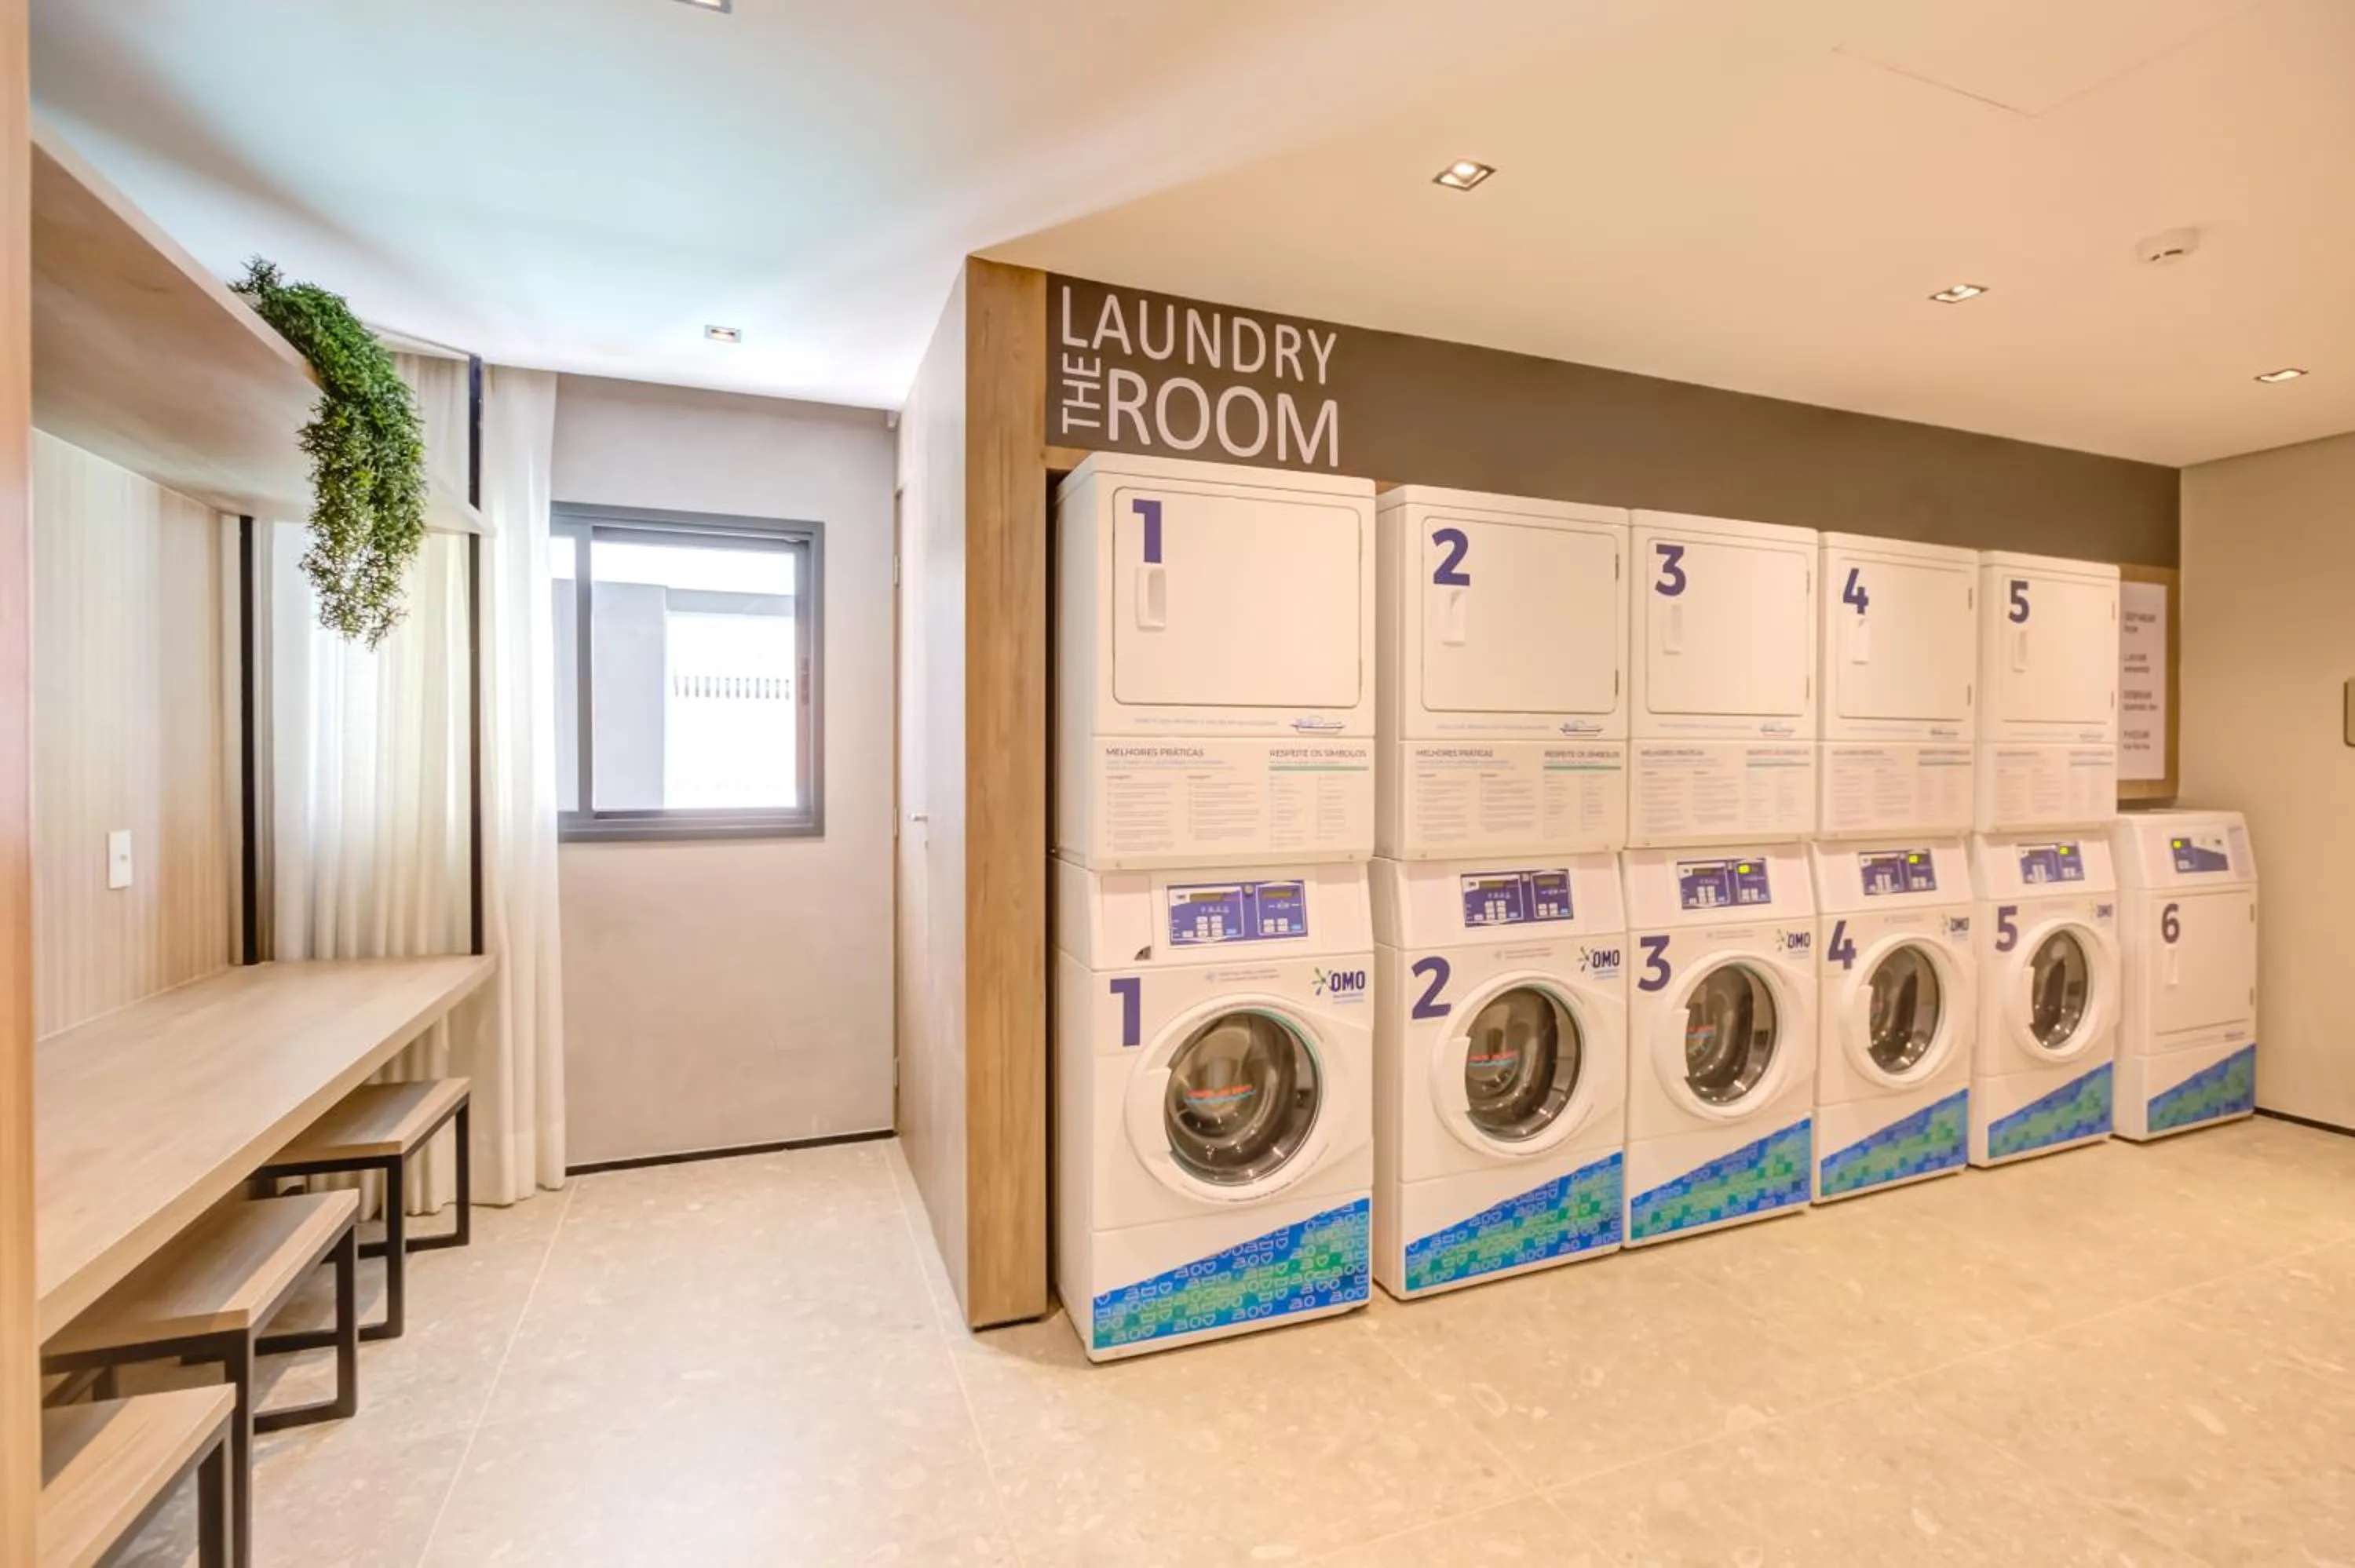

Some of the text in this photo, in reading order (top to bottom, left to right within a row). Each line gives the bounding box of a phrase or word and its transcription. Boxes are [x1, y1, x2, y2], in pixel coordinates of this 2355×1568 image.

[1062, 286, 1337, 385] LAUNDRY
[1062, 352, 1101, 434] THE
[1108, 368, 1338, 467] ROOM
[1133, 499, 1162, 563] 1
[1432, 528, 1470, 586] 2
[1655, 544, 1686, 596] 3
[1842, 567, 1869, 615] 4
[2008, 580, 2030, 624] 5
[1105, 748, 1158, 757] MELHORES
[1269, 749, 1308, 757] RESPEITE
[1310, 749, 1323, 757] OS
[1787, 931, 1811, 950] OMO
[1827, 919, 1857, 970] 4
[1995, 905, 2018, 953] 5
[2161, 903, 2181, 944] 6
[1331, 970, 1366, 993] OMO
[1592, 949, 1620, 969] OMO
[1638, 935, 1671, 992] 3
[1109, 977, 1141, 1047] 1
[1411, 956, 1451, 1020] 2
